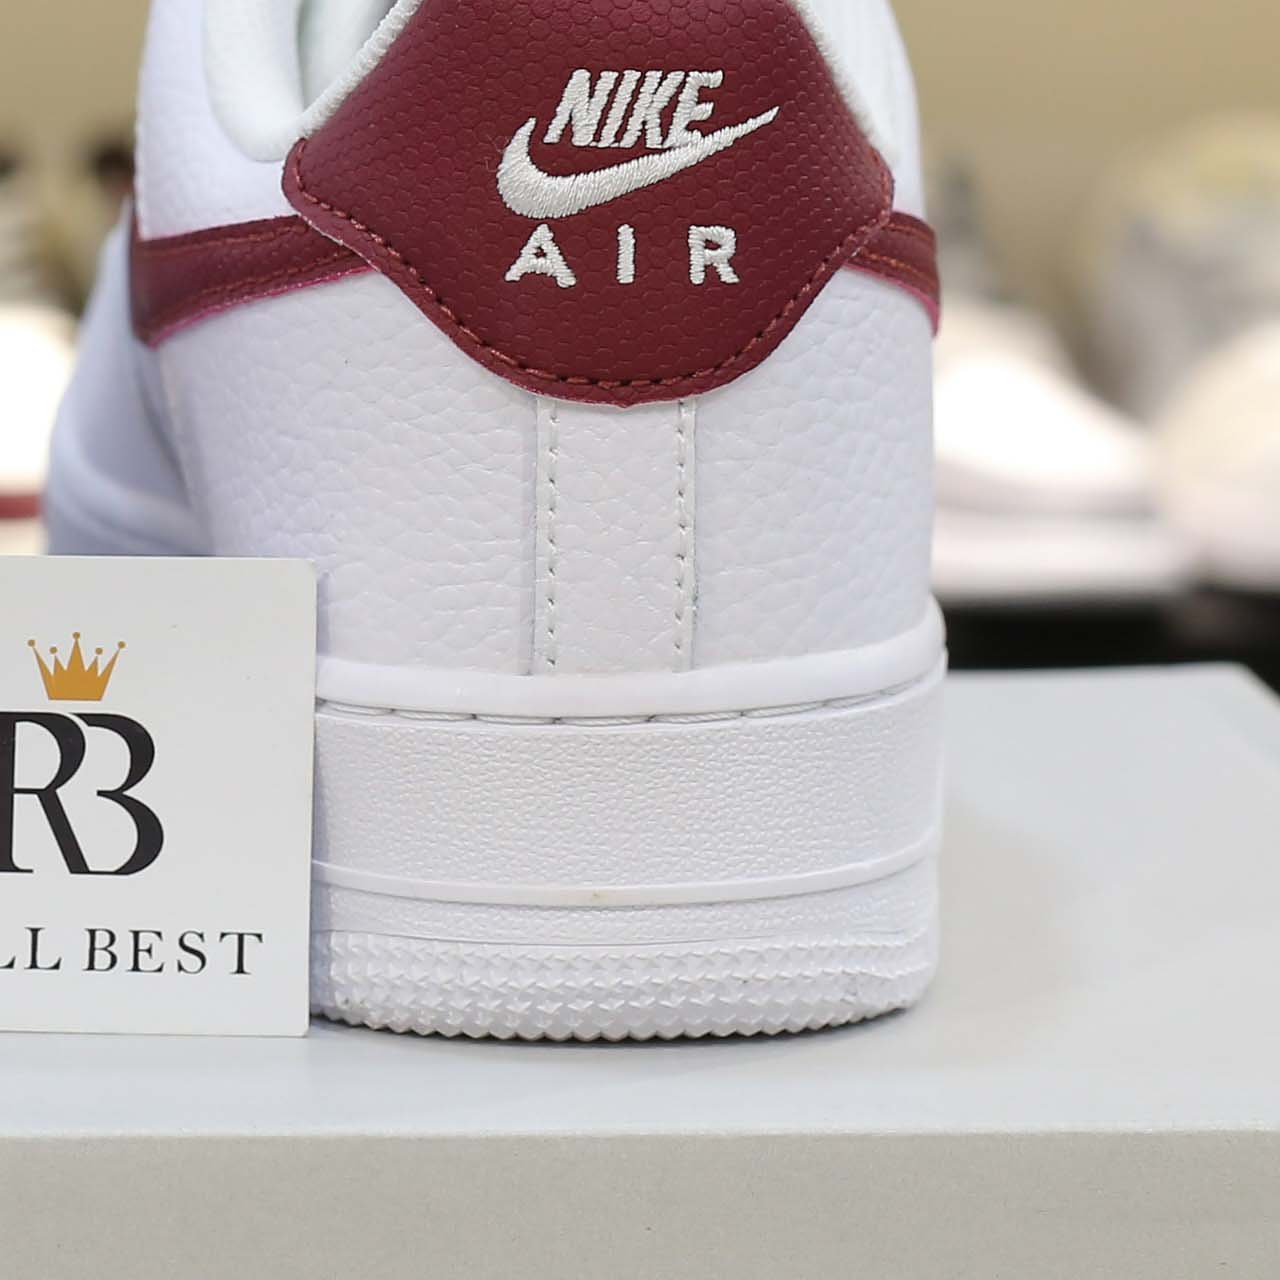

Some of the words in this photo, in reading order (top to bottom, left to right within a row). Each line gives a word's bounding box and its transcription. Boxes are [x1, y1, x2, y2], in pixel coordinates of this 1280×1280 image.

[542, 69, 725, 149] NIKE
[504, 223, 741, 288] AIR
[82, 927, 265, 976] BEST
